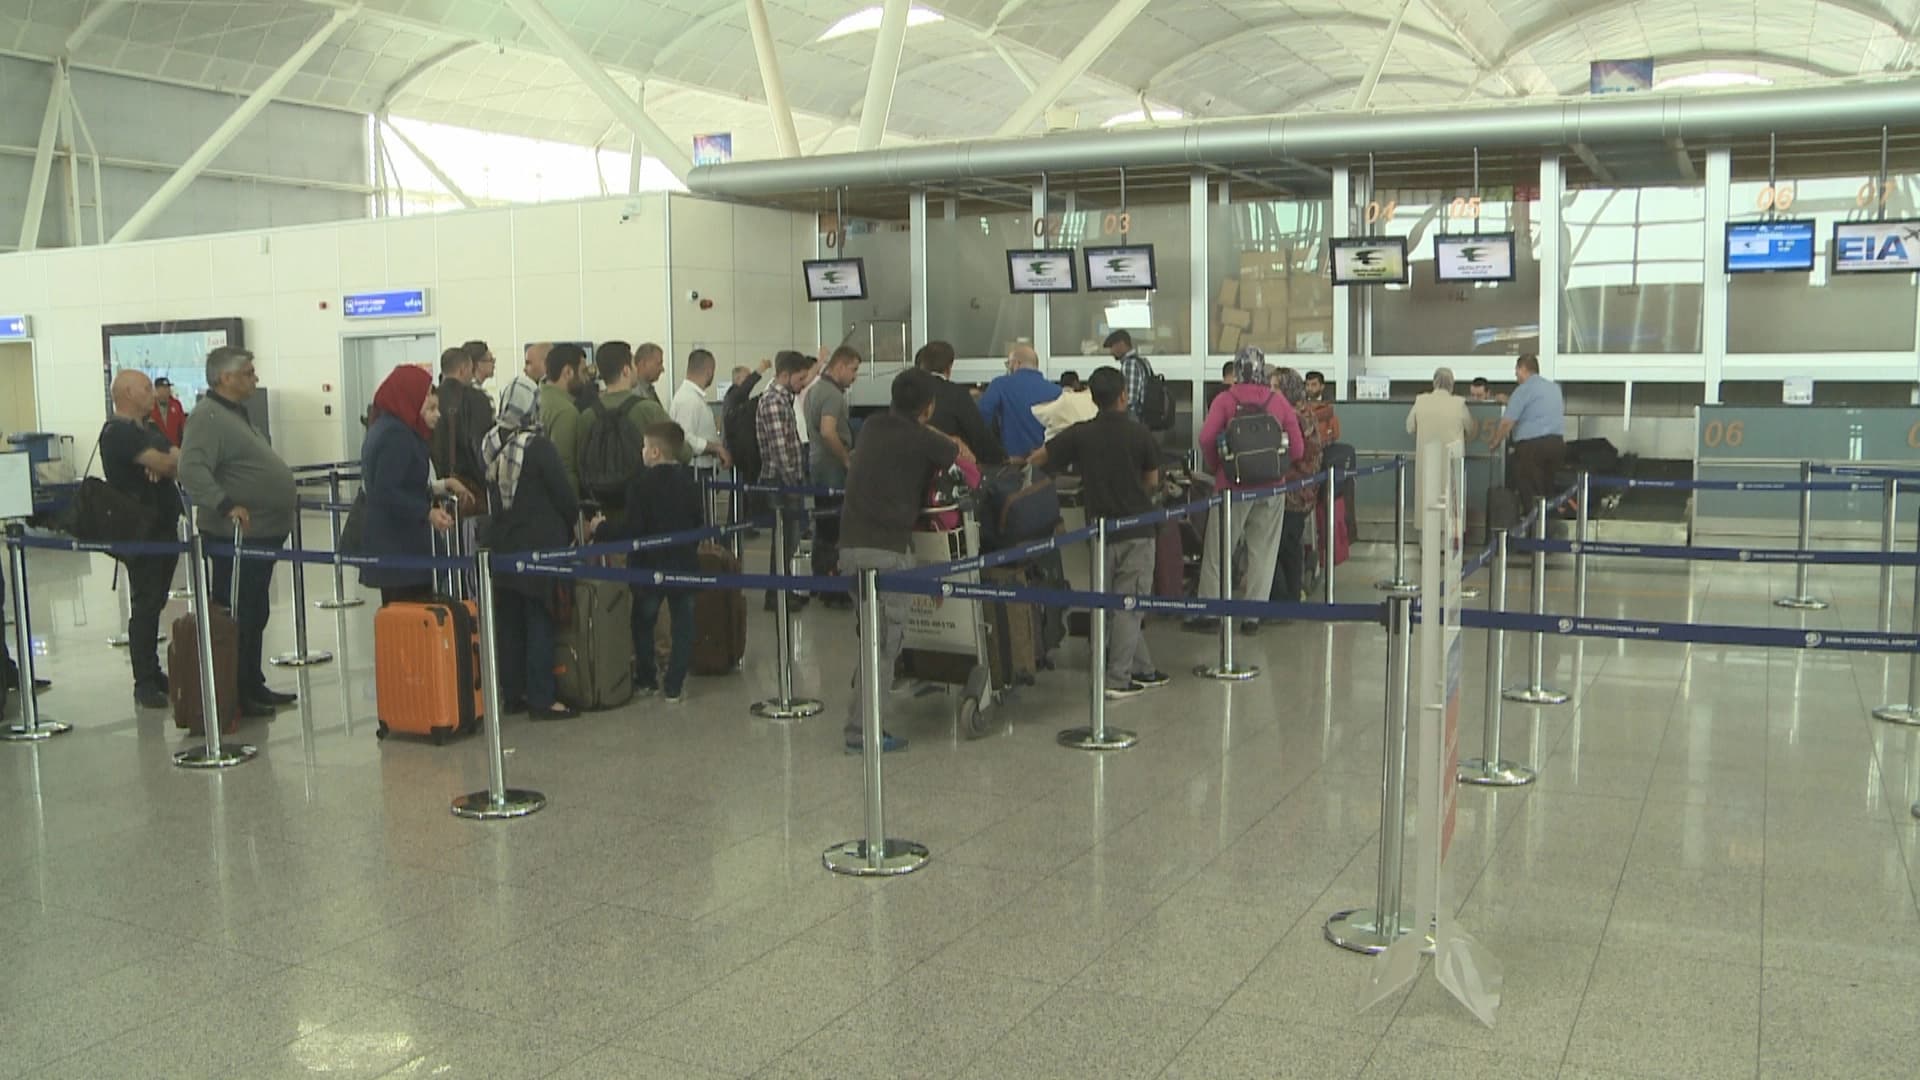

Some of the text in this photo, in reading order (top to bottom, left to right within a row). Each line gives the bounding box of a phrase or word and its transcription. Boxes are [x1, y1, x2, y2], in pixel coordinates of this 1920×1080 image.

[1451, 197, 1481, 220] 05
[1757, 186, 1794, 211] 06
[1104, 213, 1131, 235] 03
[1365, 200, 1397, 225] 04
[1839, 235, 1909, 261] EIA
[1704, 419, 1744, 448] 06
